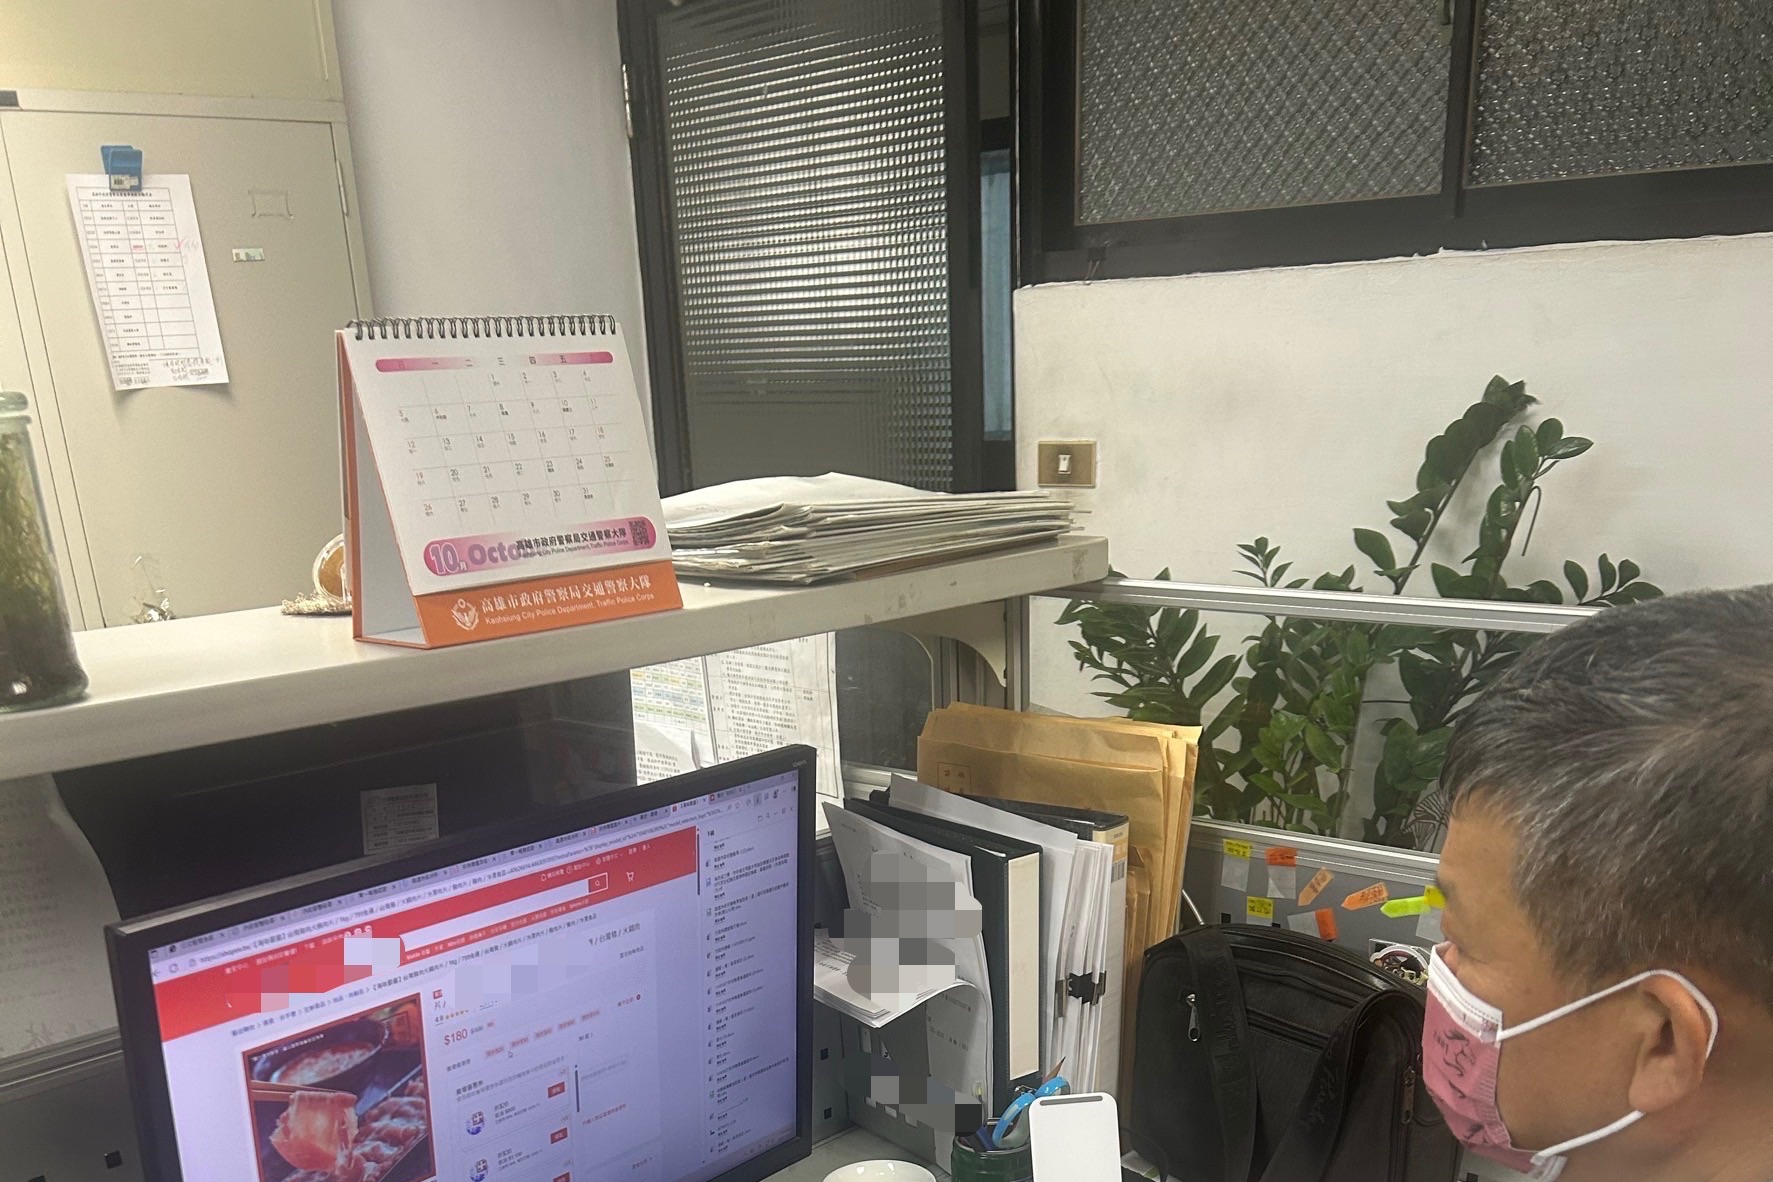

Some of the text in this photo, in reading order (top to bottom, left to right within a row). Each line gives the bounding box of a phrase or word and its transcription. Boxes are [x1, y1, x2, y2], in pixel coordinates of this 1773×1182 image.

[516, 527, 628, 551] 高雄市政府警察局交通警察大隊
[481, 574, 652, 613] 高雄市政府警察局交通警察大隊
[485, 613, 521, 625] Kaohsiung
[522, 610, 535, 622] City
[536, 607, 556, 618] Police
[596, 599, 614, 609] Traffic
[616, 596, 635, 606] Police
[636, 593, 655, 605] Corps
[444, 1028, 468, 1046] $180
